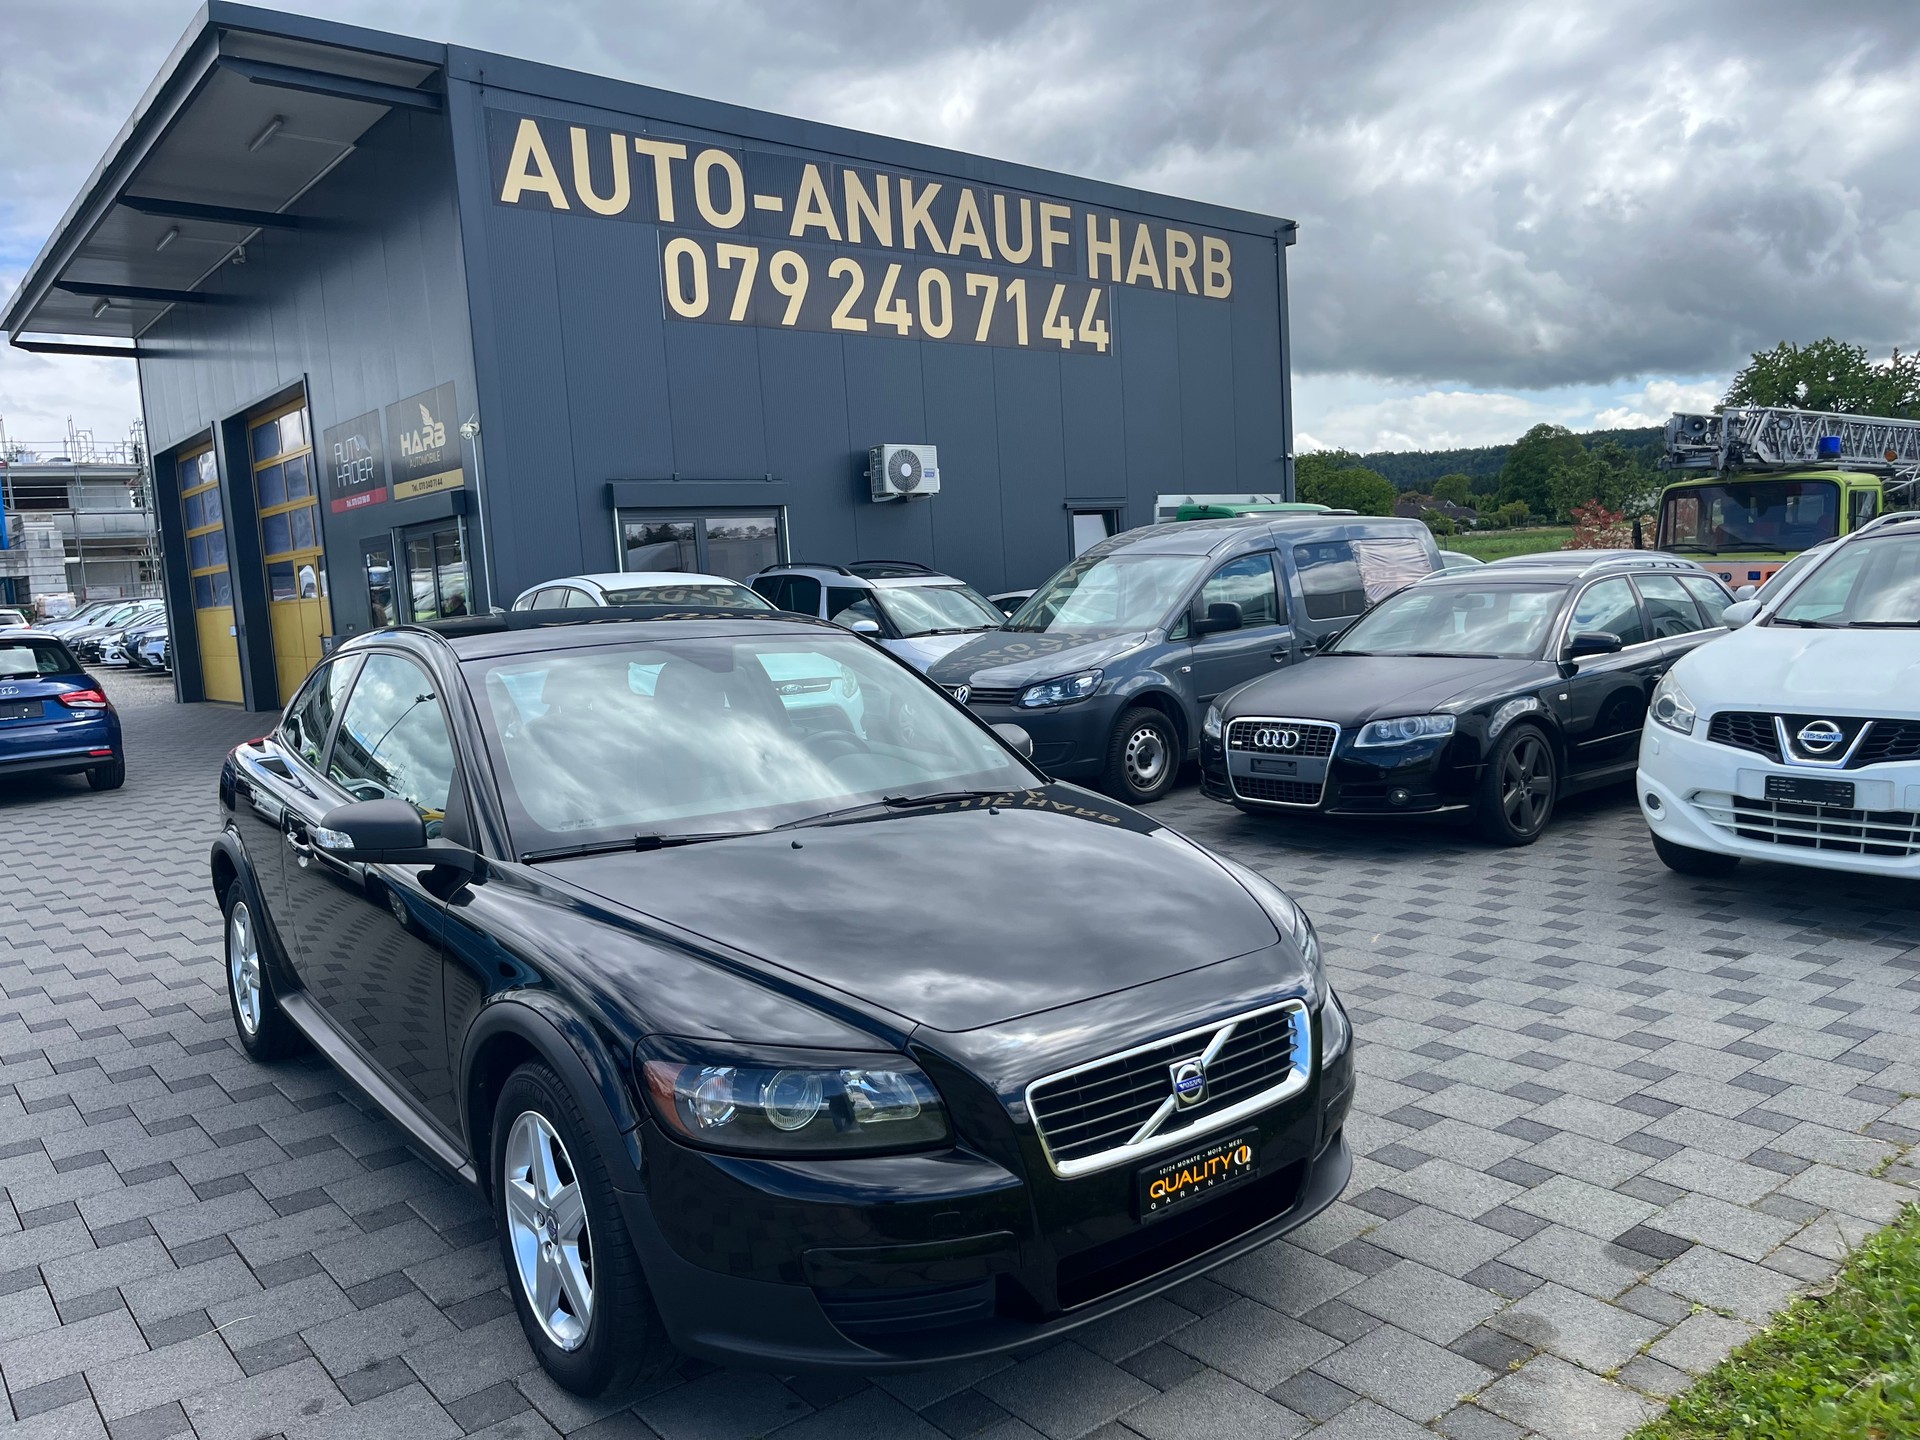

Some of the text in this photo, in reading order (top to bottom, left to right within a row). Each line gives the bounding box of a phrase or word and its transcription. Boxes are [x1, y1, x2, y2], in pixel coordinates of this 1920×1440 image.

[500, 118, 1233, 300] AUTO-ANKAUF HARB
[663, 236, 810, 327] 079
[829, 257, 954, 339] 240
[400, 421, 446, 457] HARB
[1799, 732, 1838, 741] NISSAN
[1179, 1077, 1203, 1089] VOLVO
[1149, 1152, 1233, 1199] QUALITY
[1159, 1165, 1176, 1176] 12/24
[1176, 1155, 1201, 1168] MONATE
[1207, 1146, 1222, 1157] MOIS
[1150, 1163, 1251, 1210] GARANTIE
